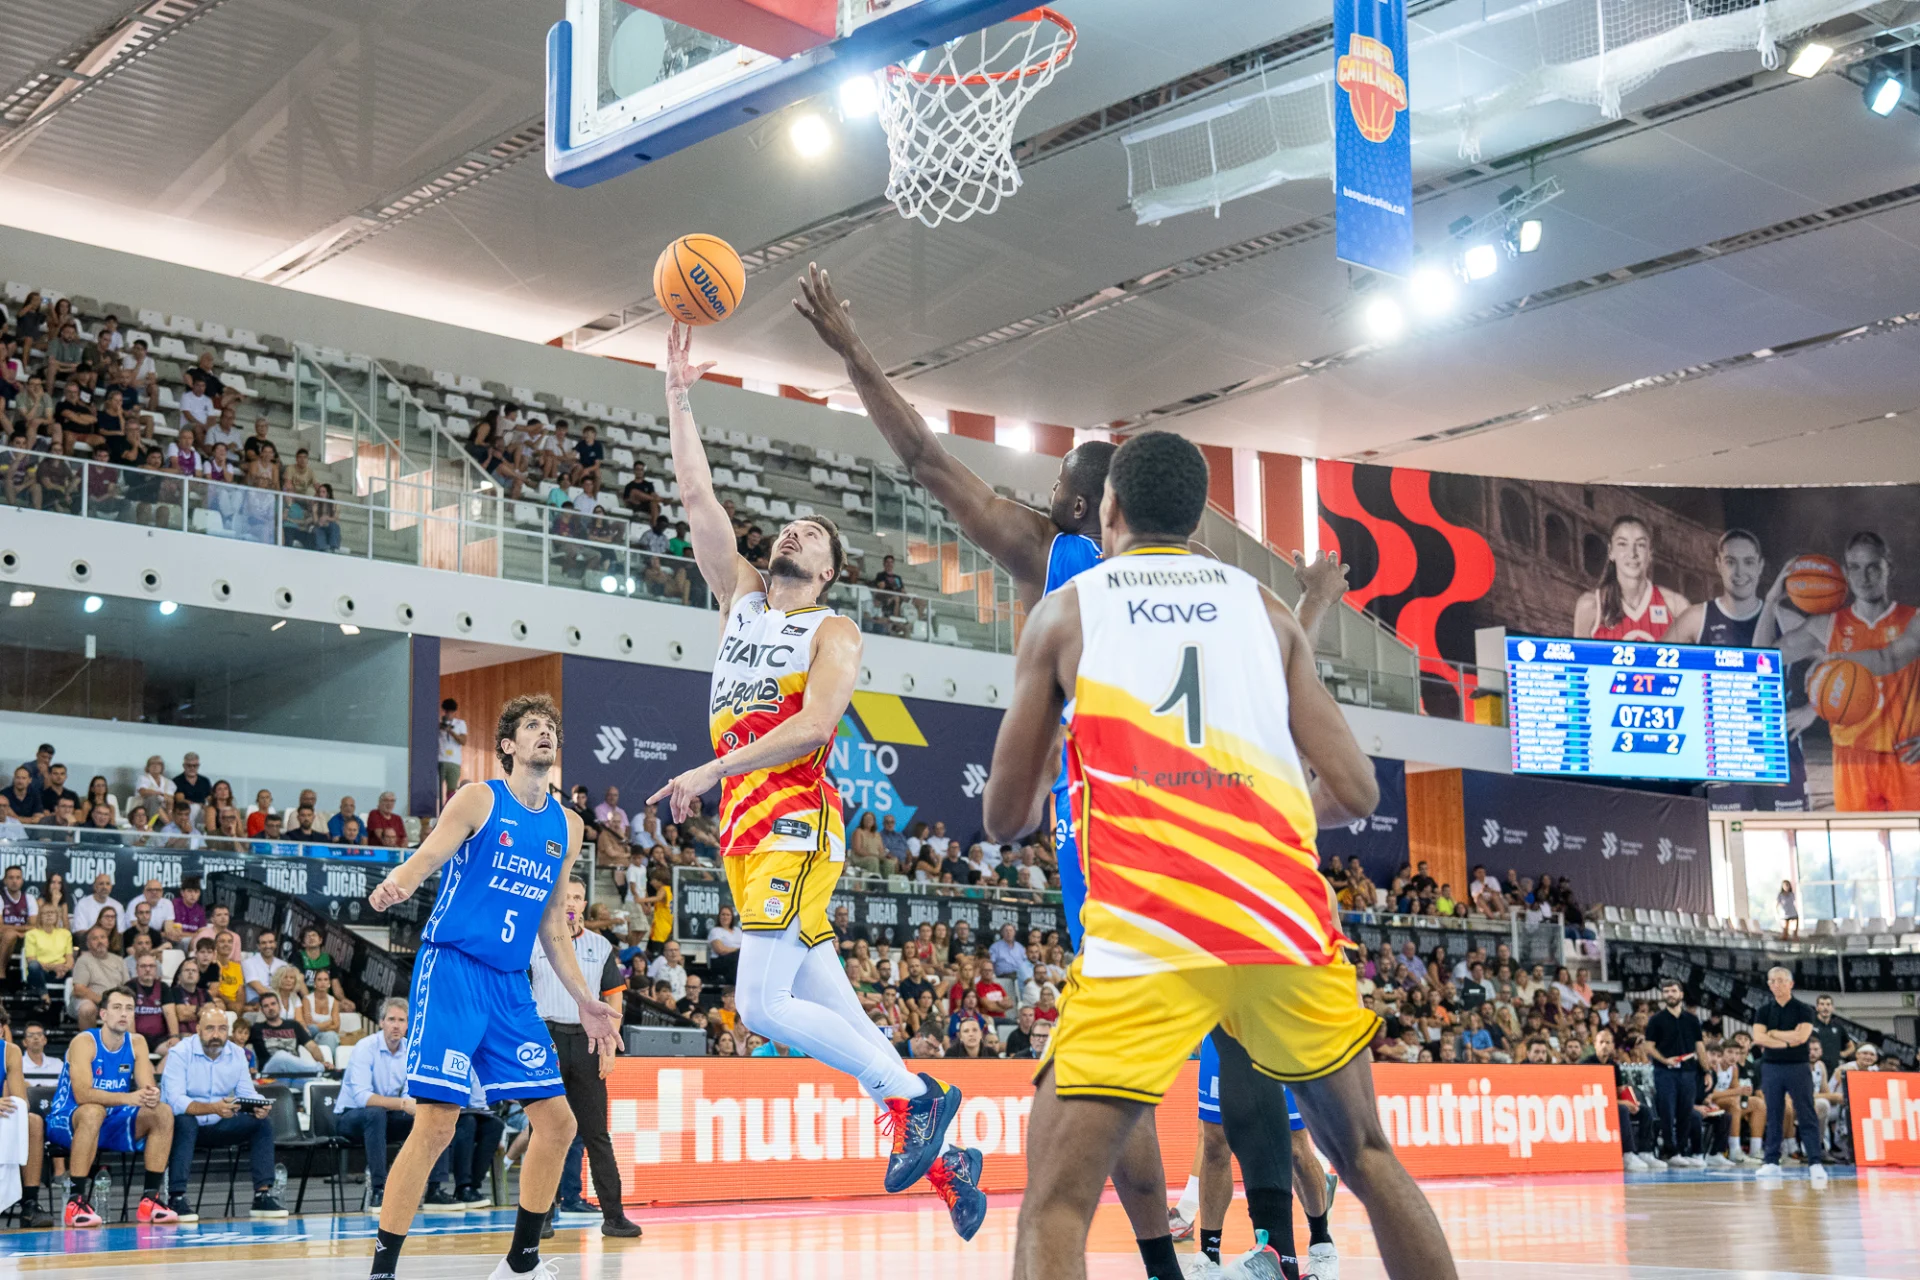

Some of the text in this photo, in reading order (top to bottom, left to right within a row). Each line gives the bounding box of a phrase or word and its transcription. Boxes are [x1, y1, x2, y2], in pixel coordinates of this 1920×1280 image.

[689, 262, 727, 316] Wilson
[1127, 598, 1218, 624] Kave
[718, 635, 795, 668] FIATC
[1612, 645, 1636, 666] 25
[1655, 647, 1680, 668] 22
[1151, 643, 1204, 746] 1
[1632, 674, 1656, 693] 2T
[1619, 705, 1675, 728] 07:31
[632, 738, 678, 751] Tarragona
[1620, 732, 1634, 752] 3
[1665, 734, 1680, 754] 2
[633, 748, 668, 761] Esports
[858, 743, 899, 775] TO
[1154, 766, 1255, 790] eurofirms
[65, 857, 117, 885] JUGAR
[133, 860, 183, 888] JUGAR
[264, 868, 308, 895] JUGAR
[322, 871, 367, 898] JUGAR
[488, 875, 548, 902] LLEIDA
[771, 881, 786, 891] acb
[685, 892, 721, 916] JUGAR
[865, 902, 898, 925] JUGAR
[908, 905, 940, 927] JUGAR
[500, 908, 519, 944] 5
[92, 1077, 127, 1090] LERNA
